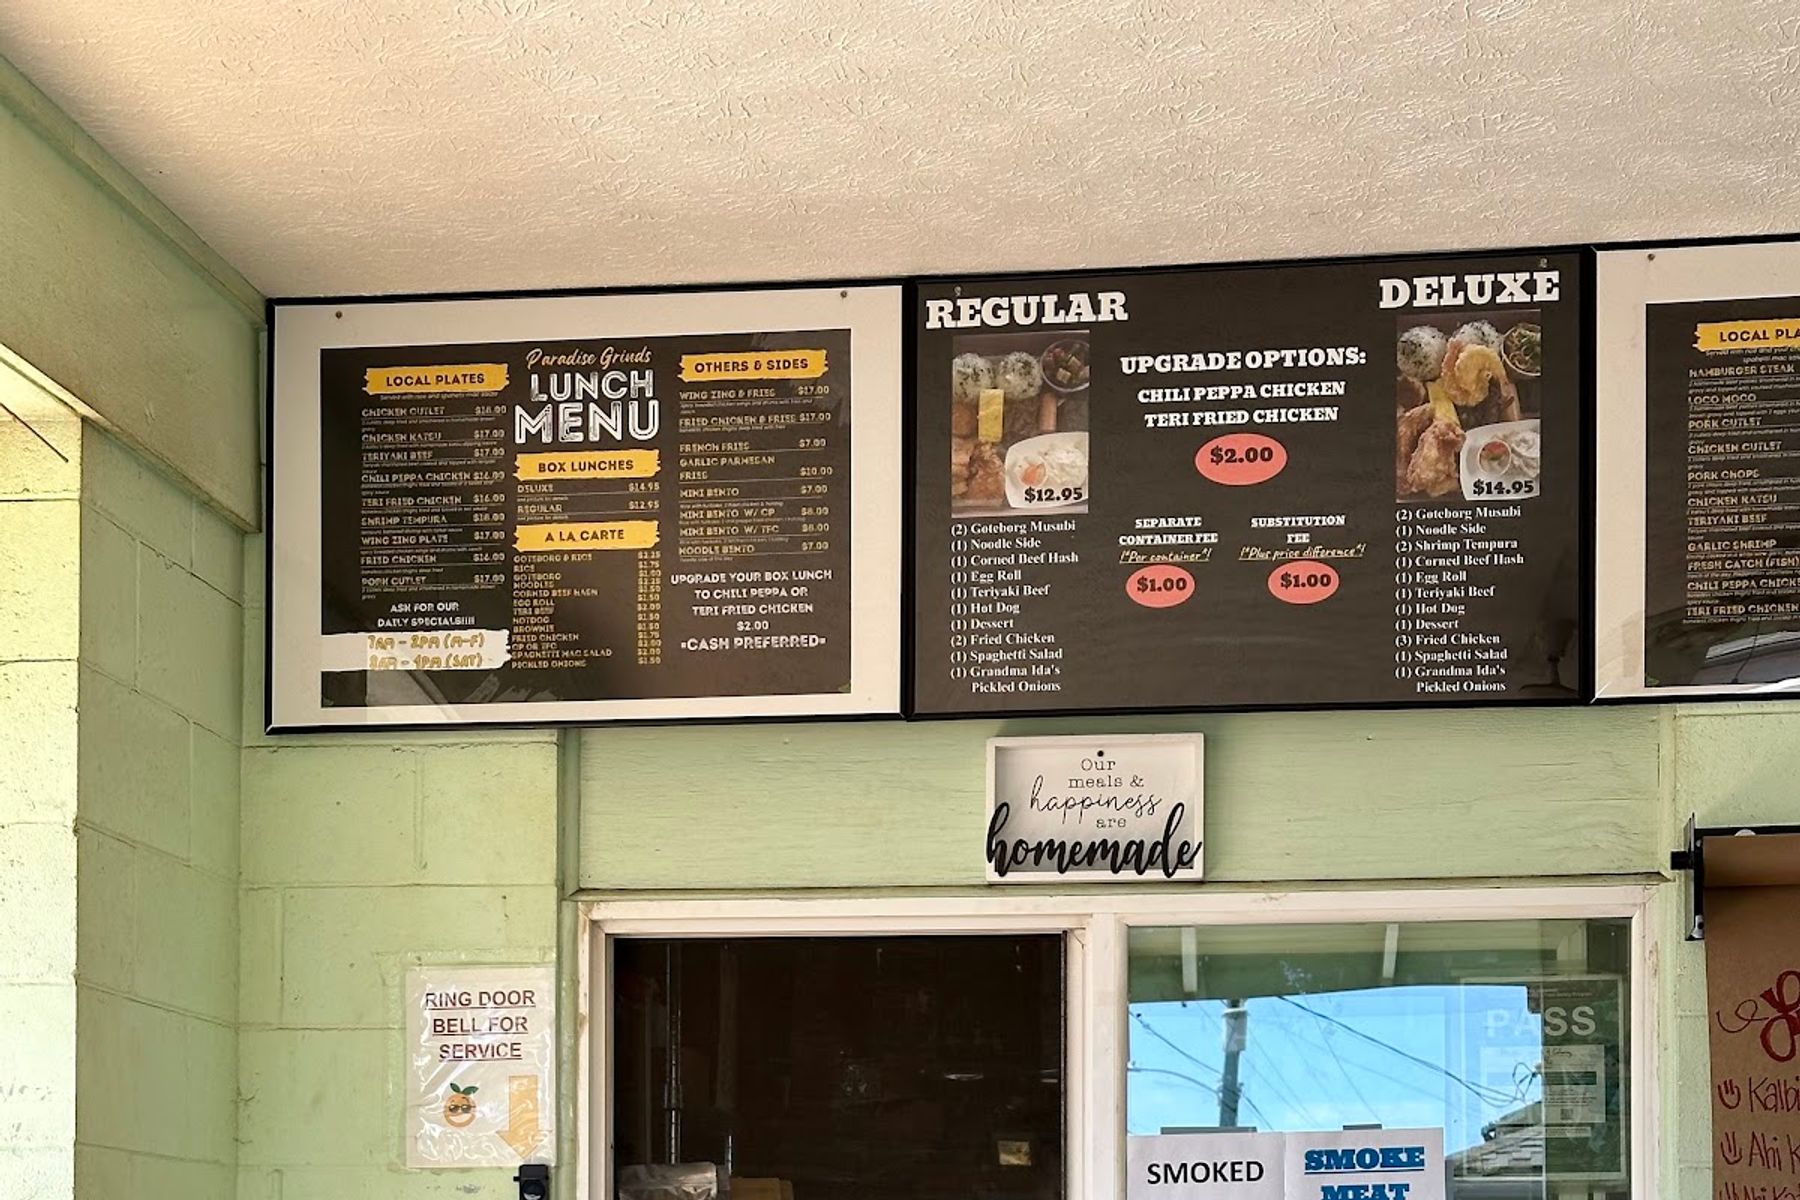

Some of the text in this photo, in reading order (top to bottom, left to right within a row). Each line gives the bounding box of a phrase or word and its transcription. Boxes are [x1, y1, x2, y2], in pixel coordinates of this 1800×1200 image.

[1379, 271, 1560, 308] DELUXE
[926, 291, 1129, 329] REGULAR
[1719, 330, 1769, 342] LOCAL
[526, 346, 652, 370] Paradise Grinds
[1120, 347, 1366, 374] UPGRADE OPTIONS:
[695, 359, 808, 373] OTHERS & SIDES
[386, 373, 485, 387] LOCAL PLATES
[530, 369, 654, 401] LUNCH
[1137, 382, 1346, 402] CHILI PEPPA CHICKEN
[515, 400, 659, 444] MENU
[1144, 407, 1339, 427] TERI FRIED CHICKEN
[1210, 446, 1274, 465] $2.00
[538, 460, 634, 473] BOX LUNCHES
[1024, 486, 1083, 503] $12.95
[1473, 478, 1534, 496] $14.95
[1396, 509, 1412, 521] (2)
[1476, 506, 1521, 518] Musubi
[951, 524, 968, 536] (2)
[1030, 520, 1076, 532] Musubi
[1135, 517, 1202, 529] SEPARATE
[1250, 515, 1346, 528] SUBSTITUTION
[545, 530, 624, 542] A LA CARTE
[1118, 533, 1219, 546] CONTAINER FEE
[1286, 534, 1310, 543] FEE
[951, 537, 1042, 552] (1) Noodle Side
[1396, 538, 1518, 553] (2) Shrimp Tempura
[951, 552, 1078, 568] (1) Corned Beef Hash
[670, 570, 832, 584] UPGRADE YOUR BOX LUNCH
[951, 570, 1022, 584] (1) Egg Roll
[1136, 576, 1187, 593] $1.00
[1280, 572, 1332, 589] $1.00
[695, 586, 808, 600] TO CHILI PEPPA OR
[951, 584, 1051, 599] (1) Teriyaki Beef
[390, 602, 459, 612] ASK FOR OUR
[692, 603, 814, 616] TERI FRIED CHICKEN
[951, 602, 1020, 616] (1) Hot Dog
[378, 618, 409, 627] DAILY
[736, 621, 770, 631] $2.00
[951, 618, 1014, 632] (1) Dessert
[950, 633, 1055, 648] (2) Fried Chicken
[1416, 634, 1447, 645] Fried
[1451, 633, 1500, 644] Chicken
[950, 648, 1063, 663] (1) Spaghetti Salad
[950, 664, 1061, 679] (1) Grandma Ida's
[971, 680, 1061, 693] Pickled Onions
[1081, 758, 1116, 771] Our
[1068, 775, 1144, 789] meals &
[1029, 774, 1163, 824] happiness
[1096, 817, 1127, 829] are
[986, 802, 1202, 878] homemade
[425, 990, 536, 1008] RING DOOR
[433, 1016, 528, 1033] BELL FOR
[439, 1042, 523, 1059] SERVICE
[1304, 1146, 1424, 1171] SMOKE
[1749, 1131, 1782, 1171] Ahi
[1147, 1161, 1264, 1184] SMOKED
